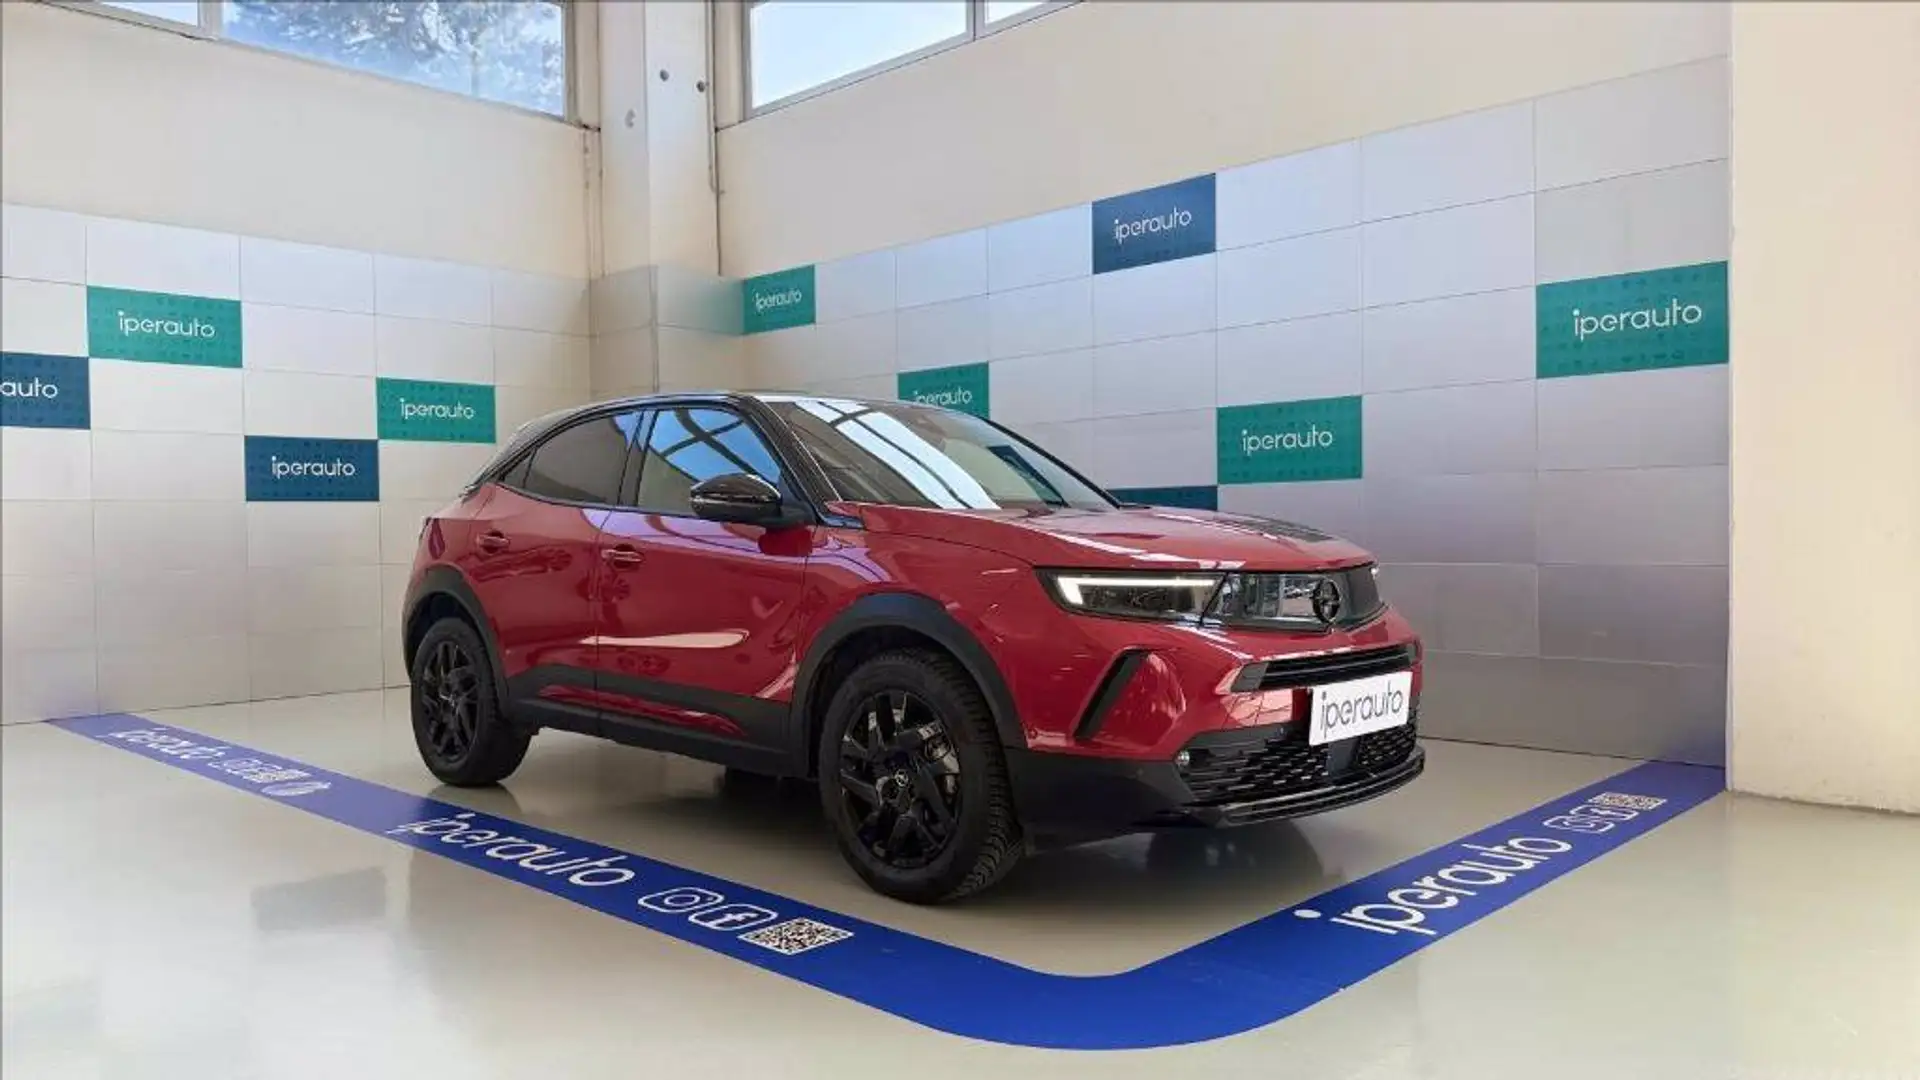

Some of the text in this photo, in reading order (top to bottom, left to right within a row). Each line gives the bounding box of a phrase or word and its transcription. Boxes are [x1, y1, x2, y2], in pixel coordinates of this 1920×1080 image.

[1114, 207, 1192, 243] iperauto
[755, 288, 802, 313] iperauto
[118, 311, 215, 339] iperauto
[1573, 298, 1702, 341] iperauto
[0, 377, 58, 399] auto
[400, 398, 475, 420] iperauto
[1242, 424, 1333, 456] iperauto
[272, 456, 355, 478] iperauto
[1320, 682, 1403, 737] iperauto
[385, 812, 636, 887] iperauto
[1294, 836, 1573, 935] iperauto
